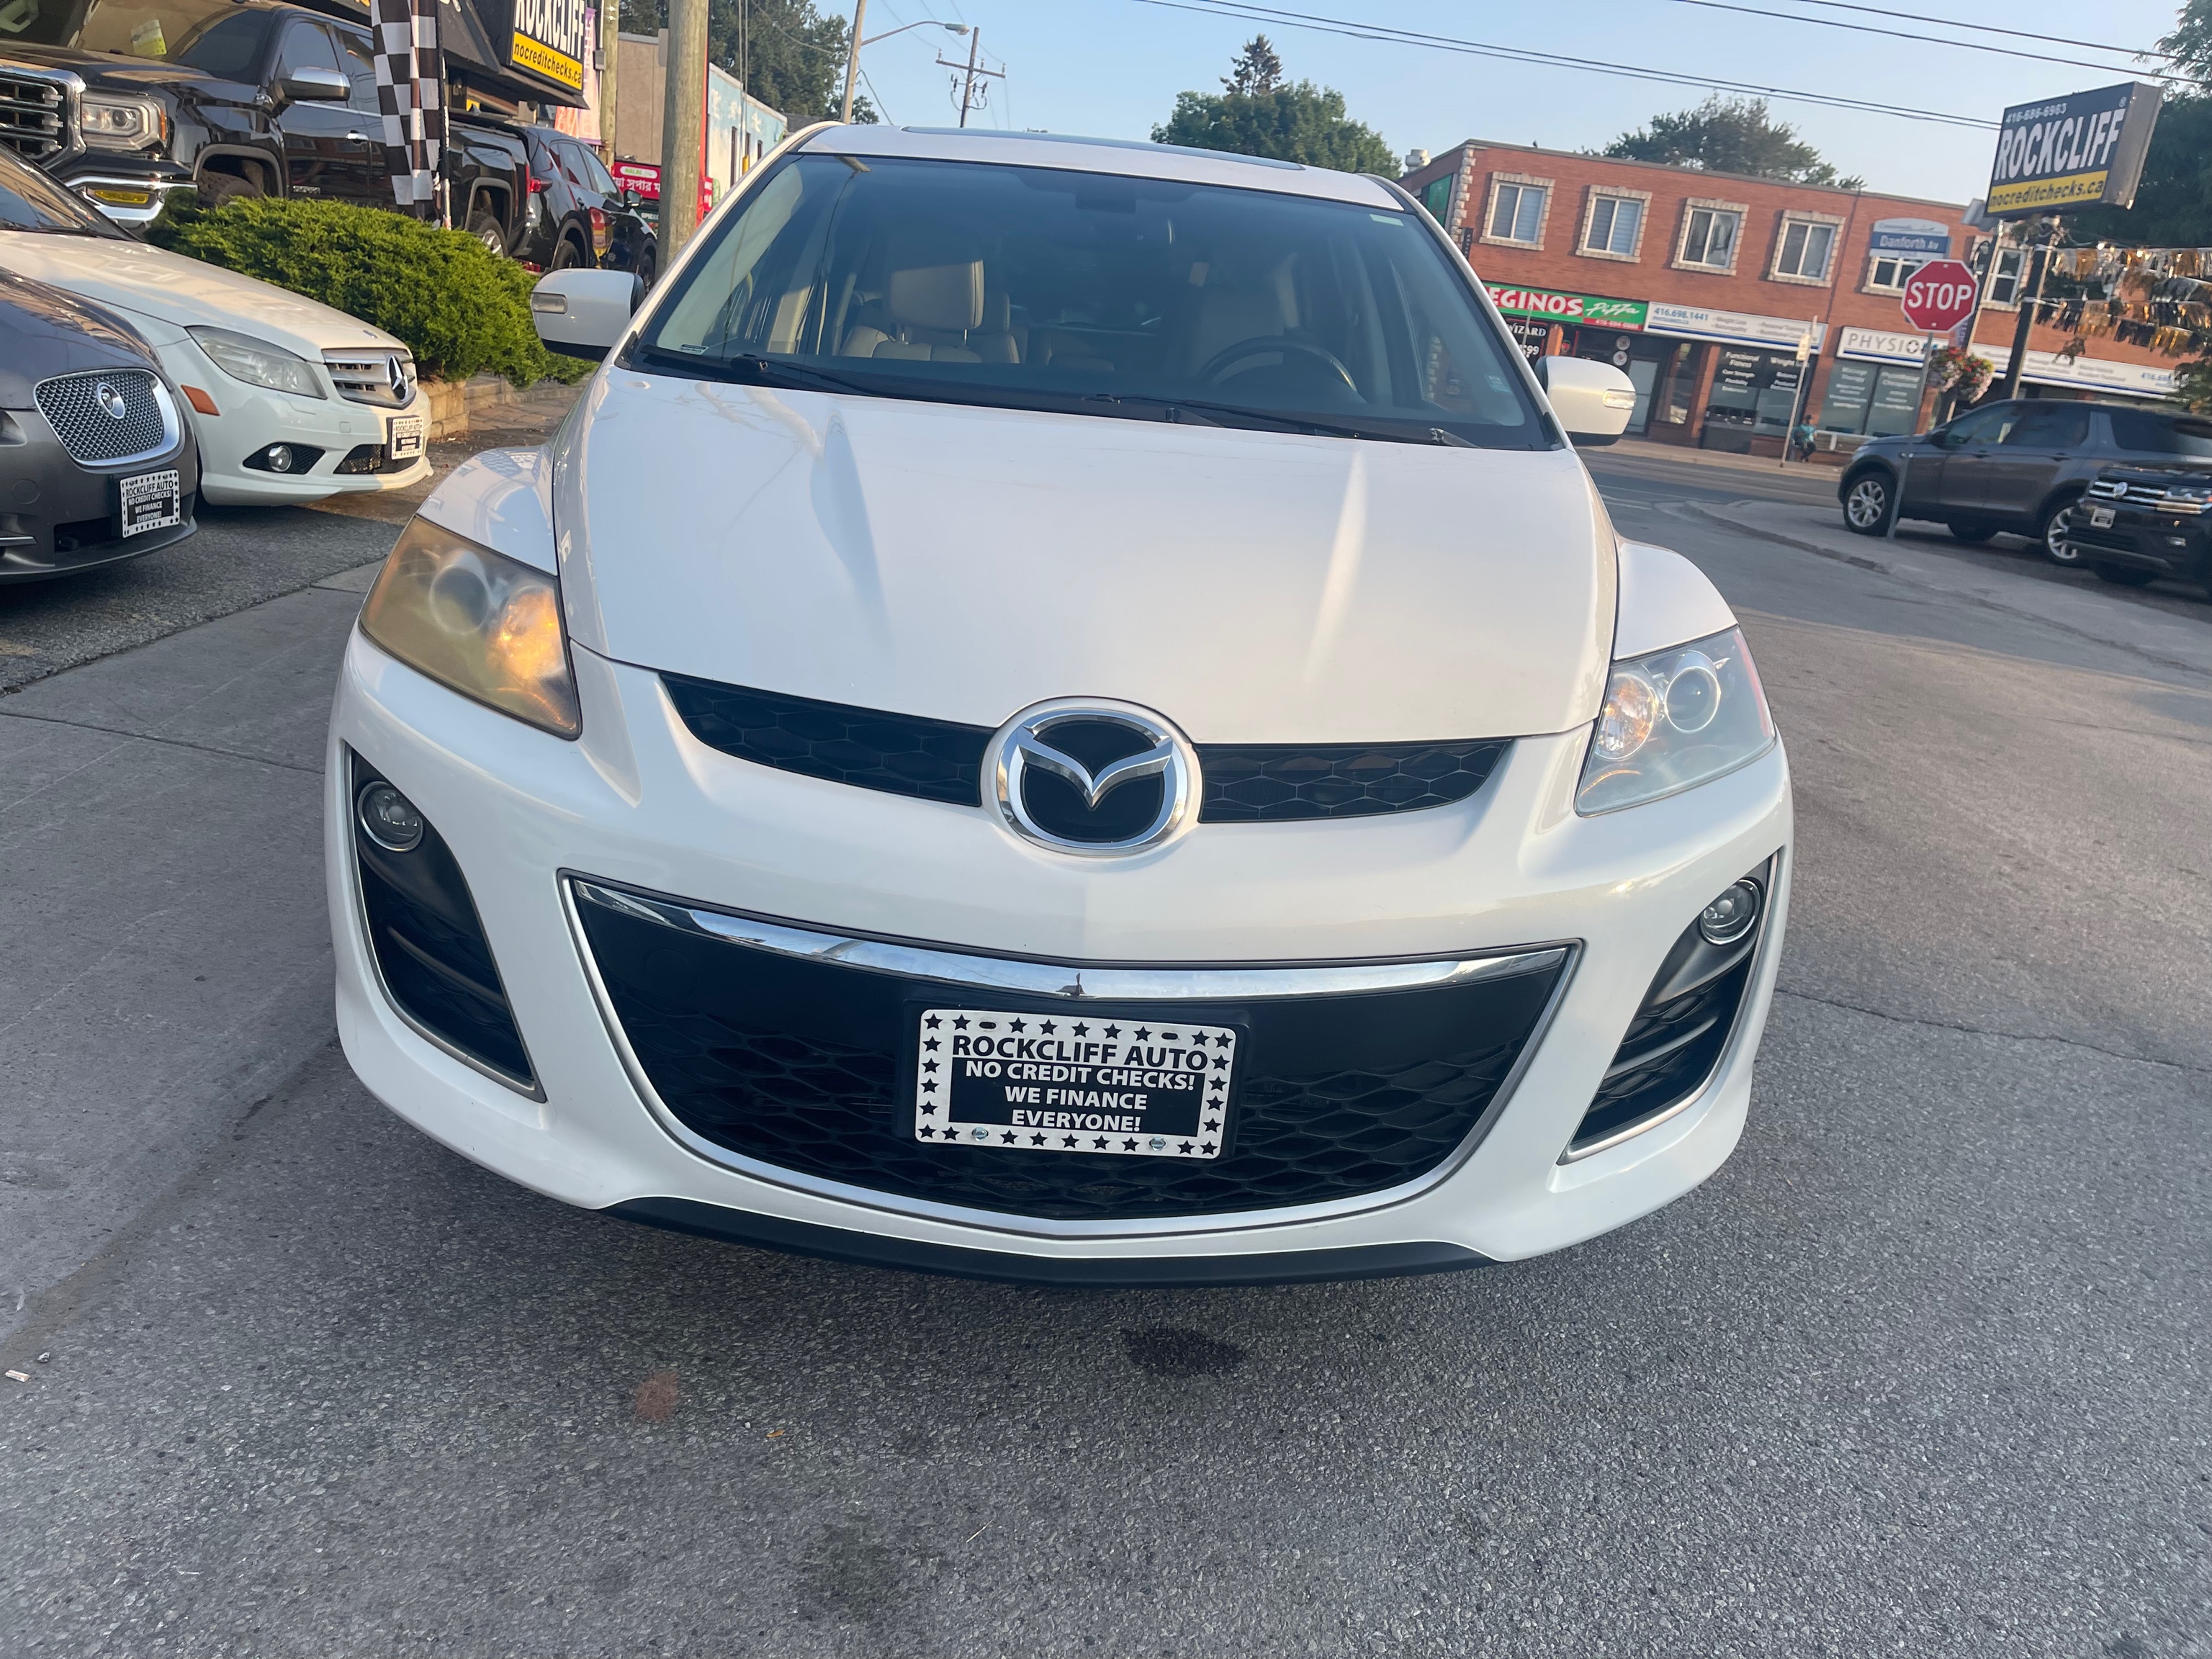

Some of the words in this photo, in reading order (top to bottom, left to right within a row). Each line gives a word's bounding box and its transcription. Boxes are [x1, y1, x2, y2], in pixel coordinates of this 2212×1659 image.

[513, 42, 581, 84] nocreditchecks.ca
[1994, 109, 2126, 181] ROCKCLIFF
[1990, 180, 2105, 207] nocreditchecks.ca
[1879, 235, 1926, 249] Danforth
[1488, 287, 1583, 315] EGINOS
[1908, 282, 1972, 310] STOP
[1654, 307, 1709, 320] 416.698.1441
[125, 482, 156, 498] ROCKCLIFF
[156, 480, 173, 490] AUTO
[135, 494, 151, 504] CREDIT
[151, 490, 172, 500] CHECKS!
[136, 511, 162, 523] EVERYONE!
[143, 500, 163, 512] FINANCE
[952, 1035, 1118, 1064] ROCKCLIFF
[1124, 1046, 1208, 1071] AUTO
[965, 1060, 1002, 1078] NO
[1007, 1063, 1092, 1084] CREDIT
[1096, 1069, 1195, 1092] CHECKS!
[1004, 1086, 1040, 1105] WE
[1046, 1089, 1148, 1110] FINANCE
[1012, 1109, 1141, 1133] EVERYONE!
